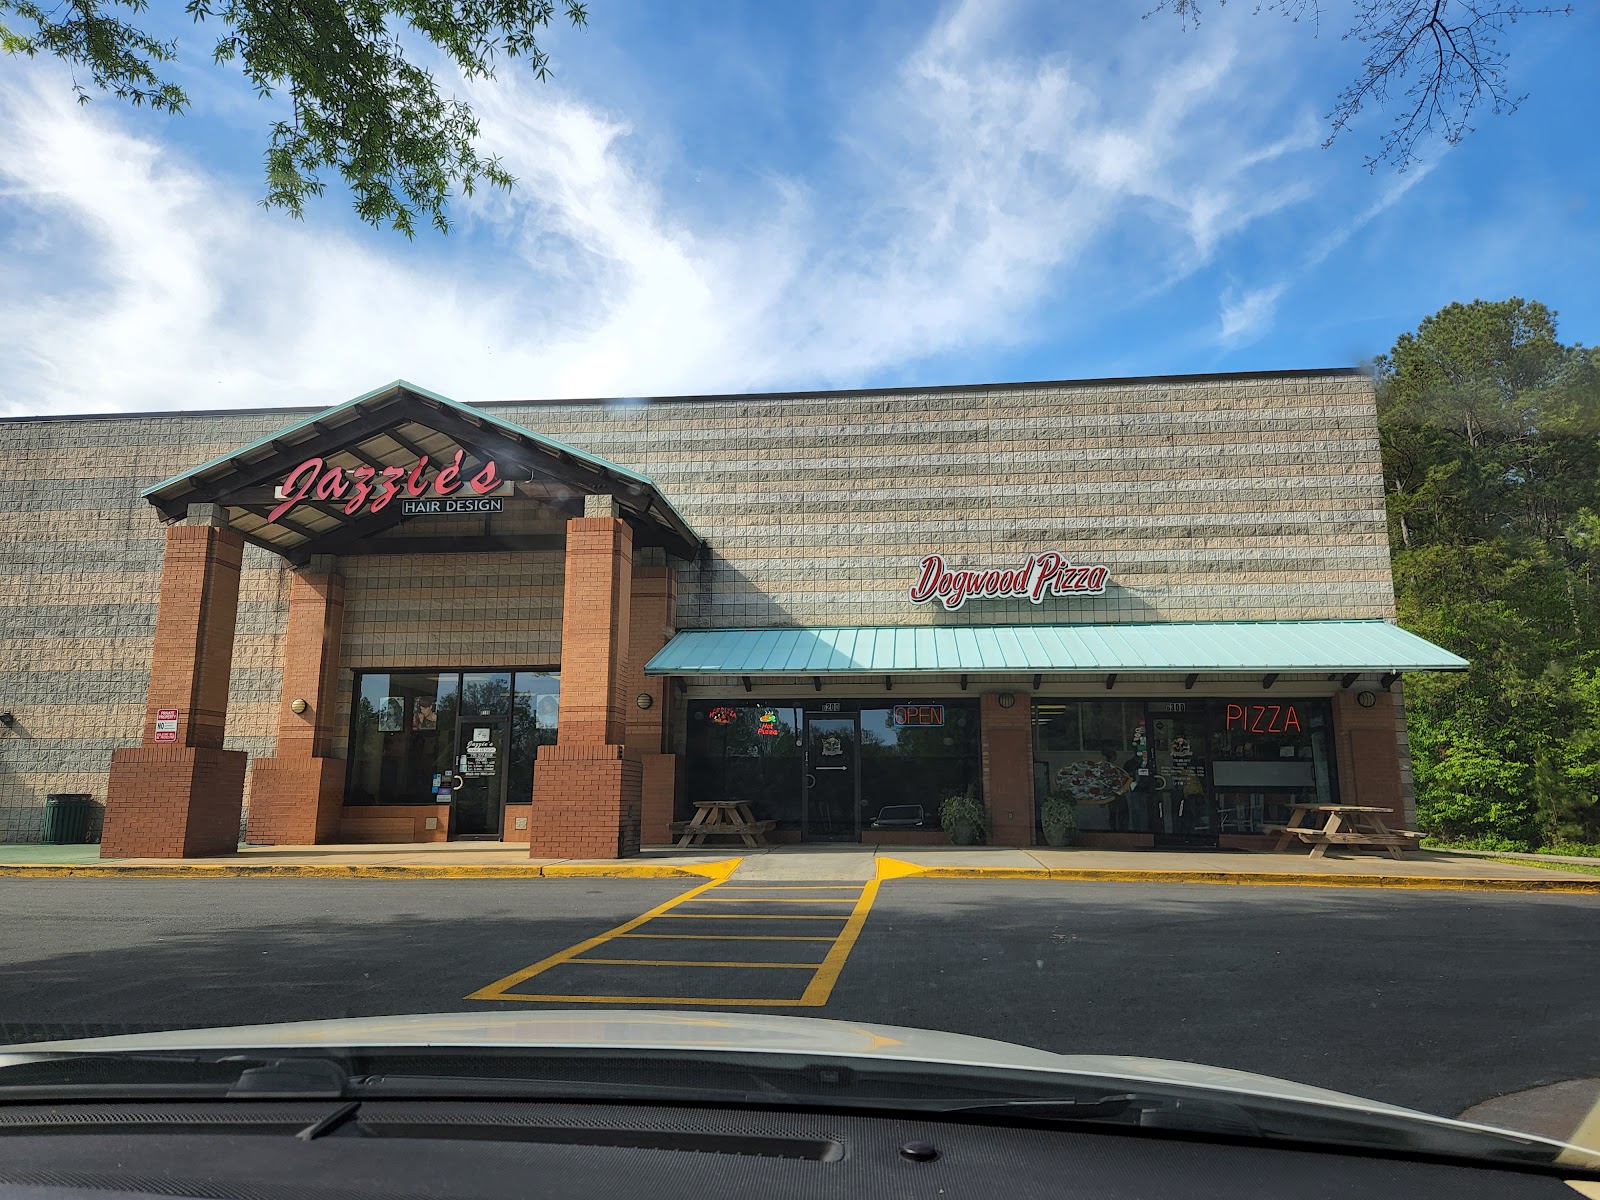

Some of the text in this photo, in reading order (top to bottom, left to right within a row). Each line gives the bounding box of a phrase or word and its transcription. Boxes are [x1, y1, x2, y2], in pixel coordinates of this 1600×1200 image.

[267, 448, 503, 523] Jazzie's
[405, 499, 502, 513] HAIR DESIGN
[910, 551, 1106, 606] Dogwood Pizza
[895, 706, 943, 725] OPEN
[1226, 704, 1301, 733] PIZZA
